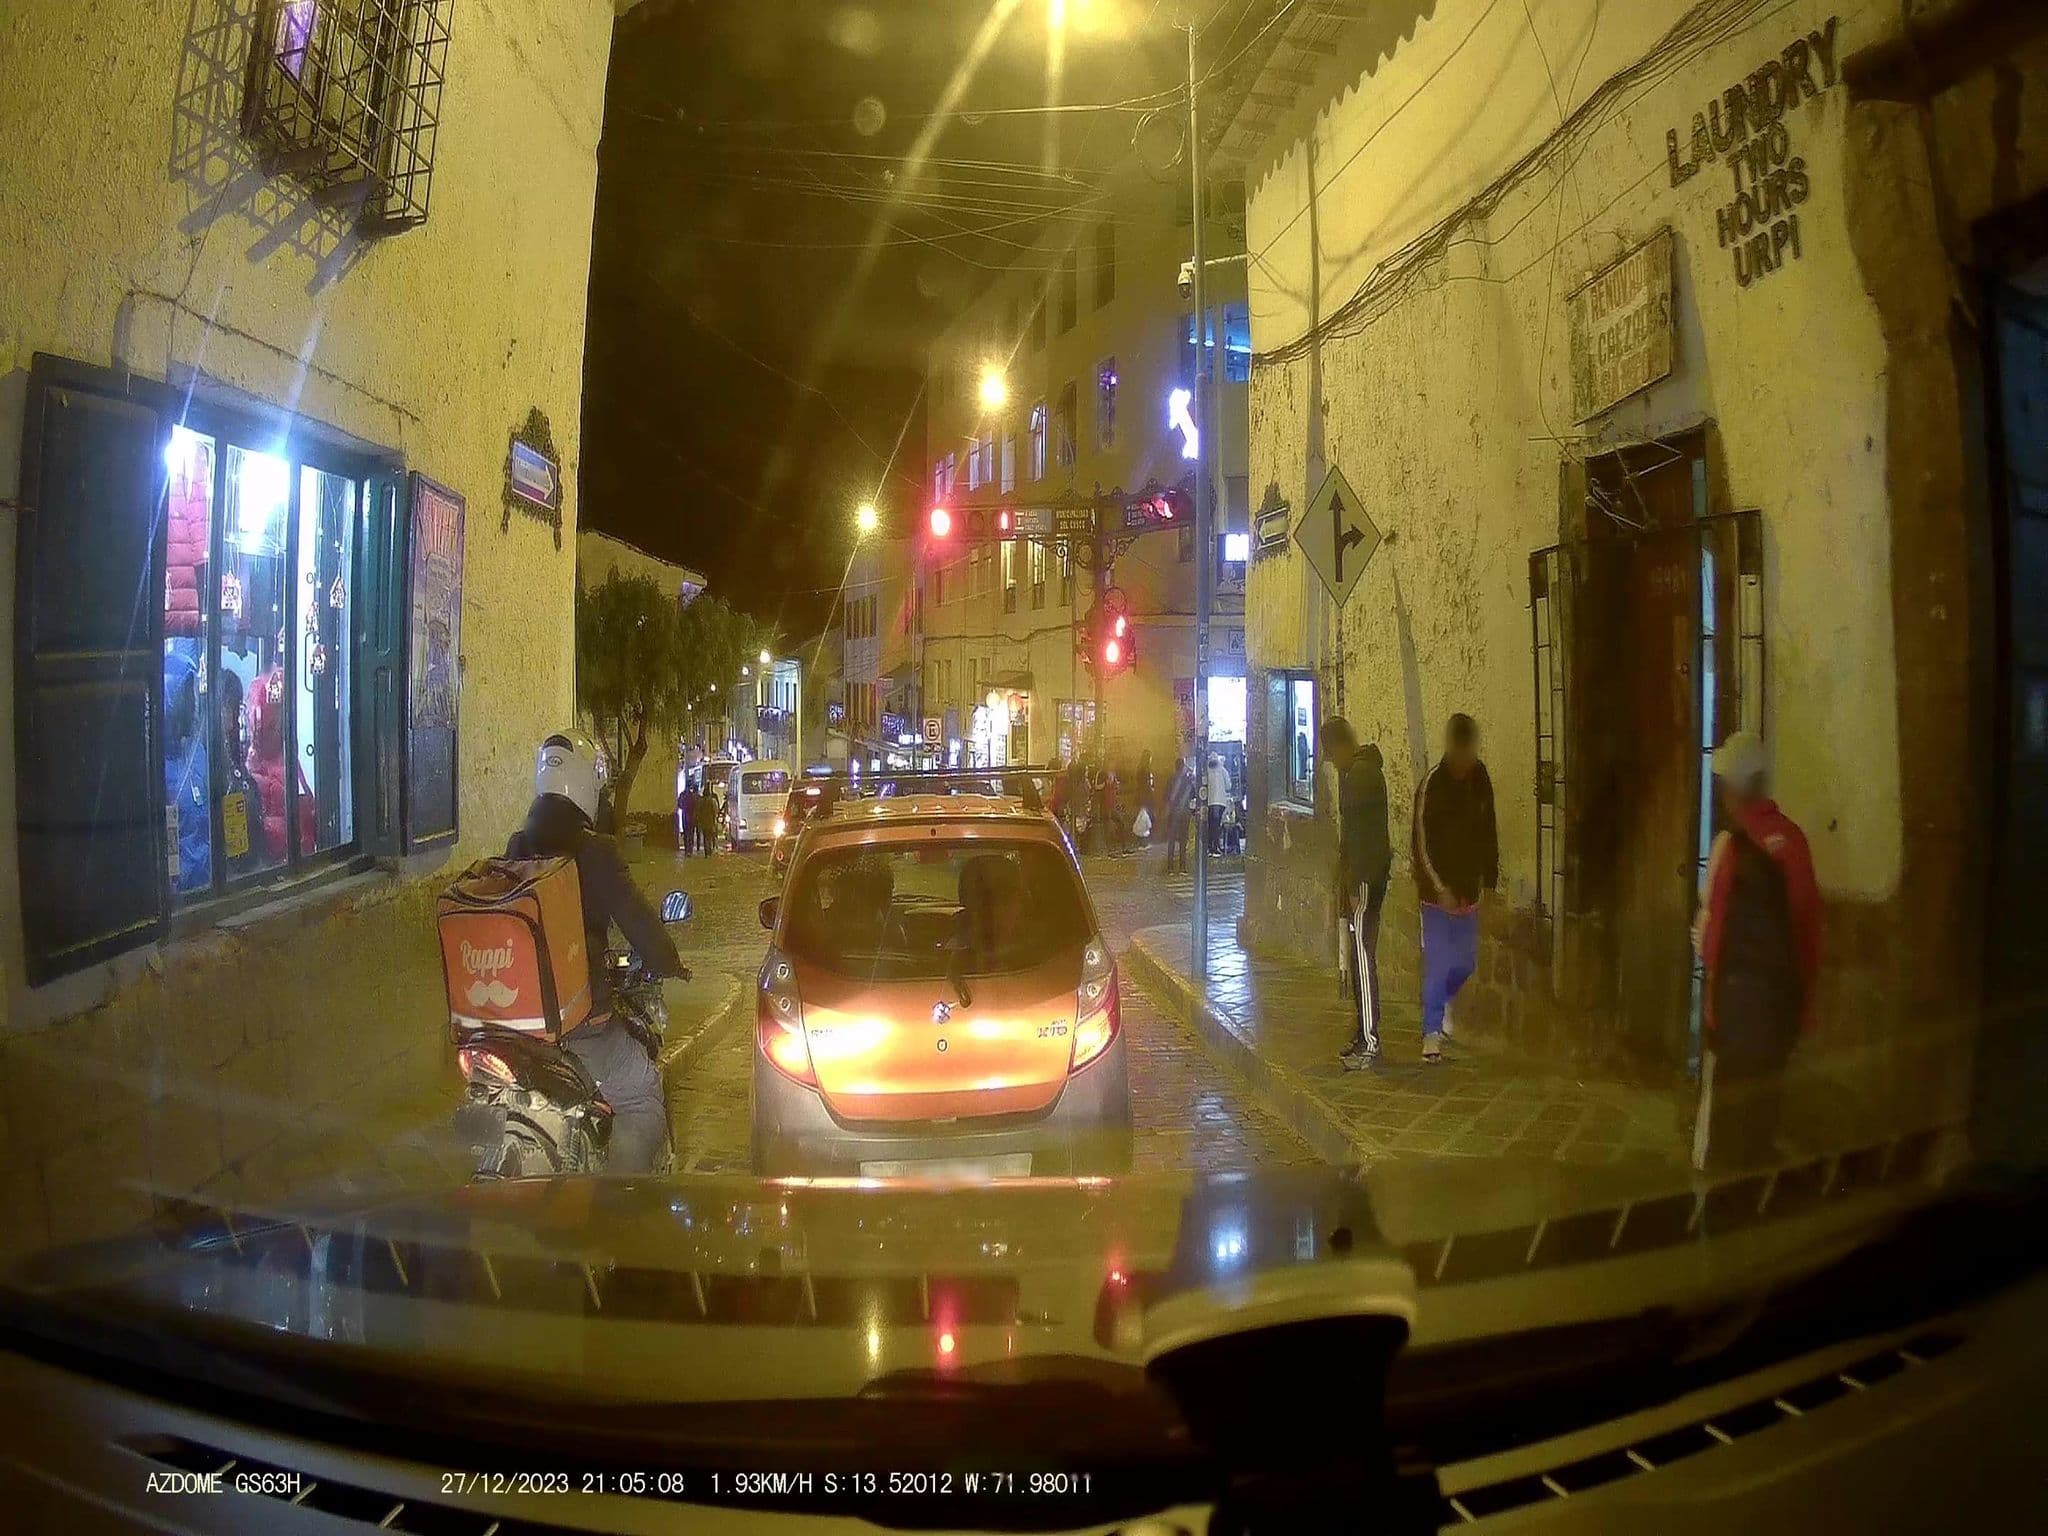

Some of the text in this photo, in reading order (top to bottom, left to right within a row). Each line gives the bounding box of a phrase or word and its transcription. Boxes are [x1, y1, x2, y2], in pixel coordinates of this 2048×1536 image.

[1666, 15, 1836, 188] LAUNDRY
[1726, 121, 1788, 194] TWO
[1716, 156, 1808, 248] HOURS
[1733, 214, 1800, 288] URPI
[459, 938, 515, 978] Rappi
